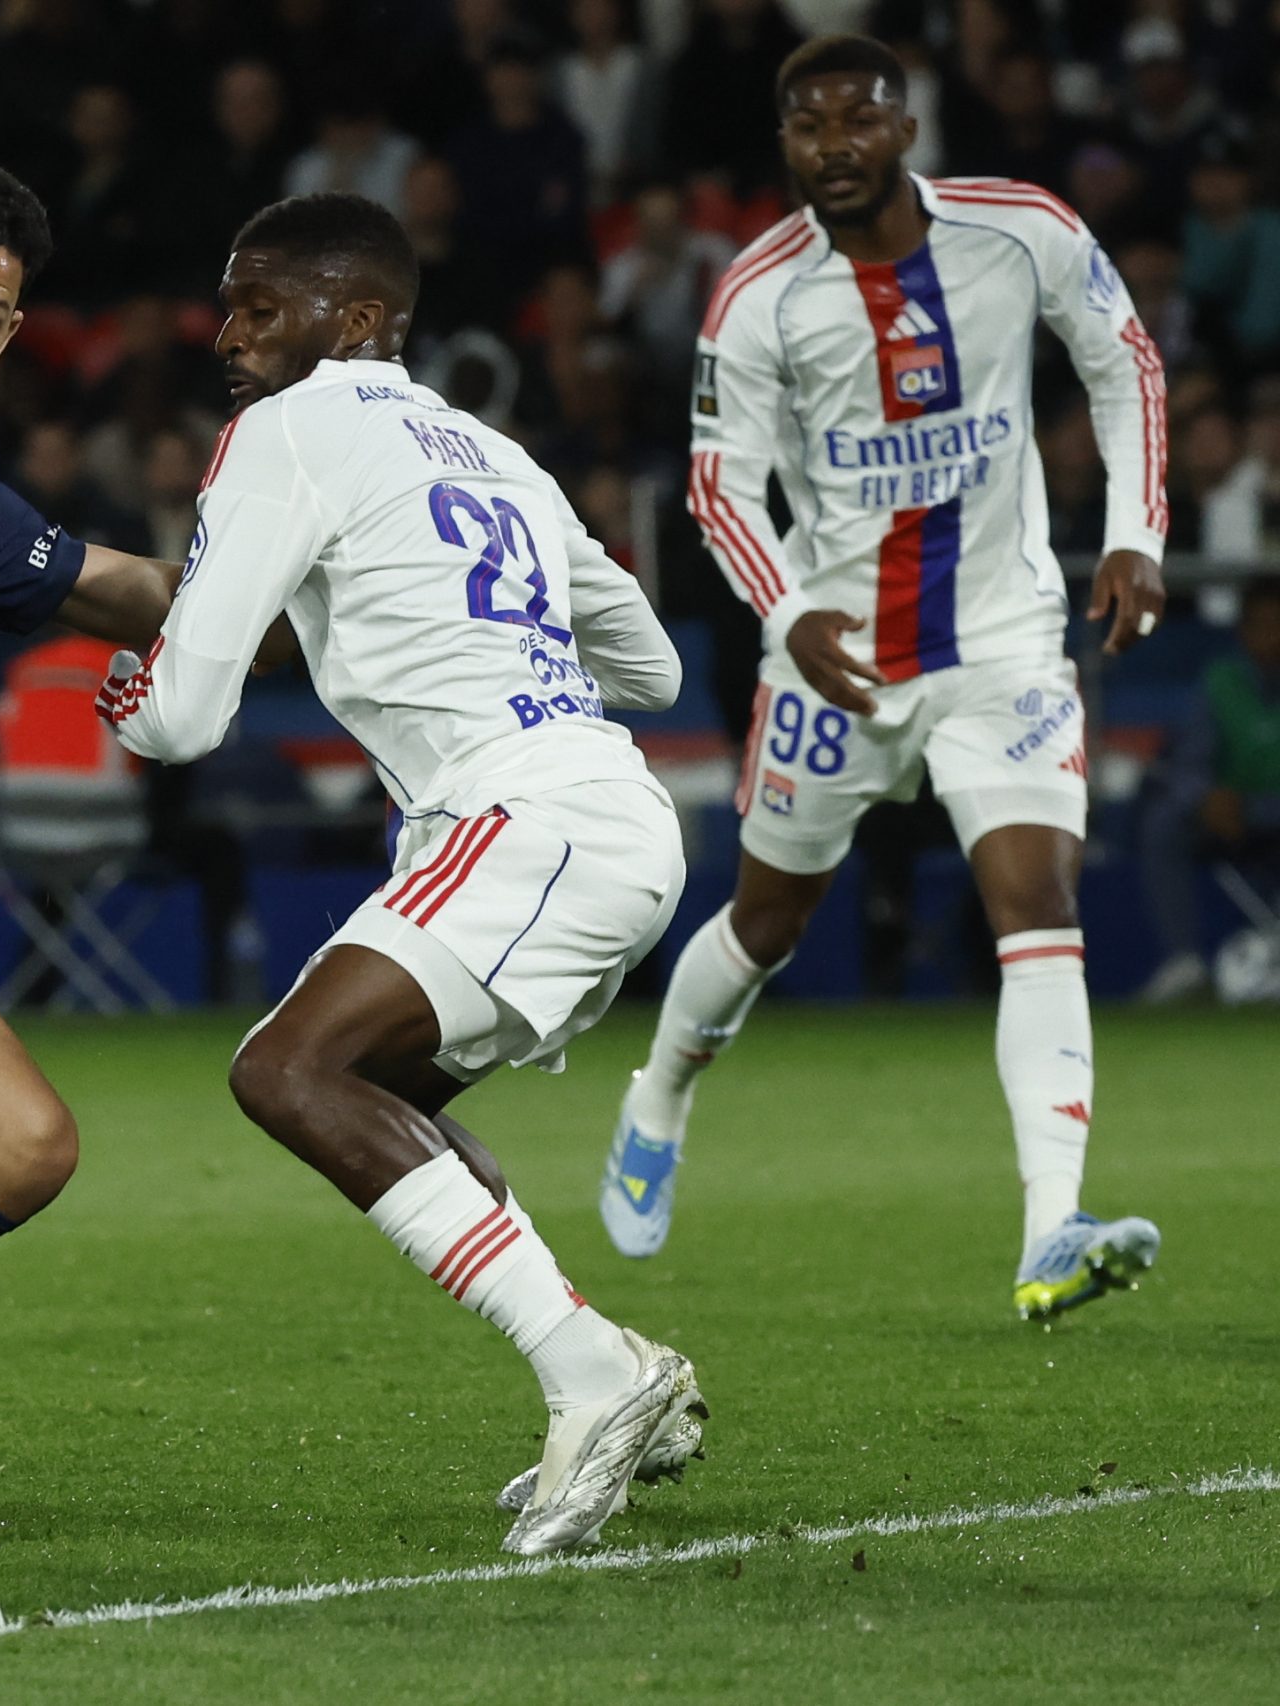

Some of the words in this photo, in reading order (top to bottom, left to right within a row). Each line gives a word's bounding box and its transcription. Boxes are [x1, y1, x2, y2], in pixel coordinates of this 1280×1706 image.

[861, 474, 901, 507] FLY
[911, 455, 991, 504] BETER
[427, 482, 573, 649] 22
[769, 691, 851, 777] 98
